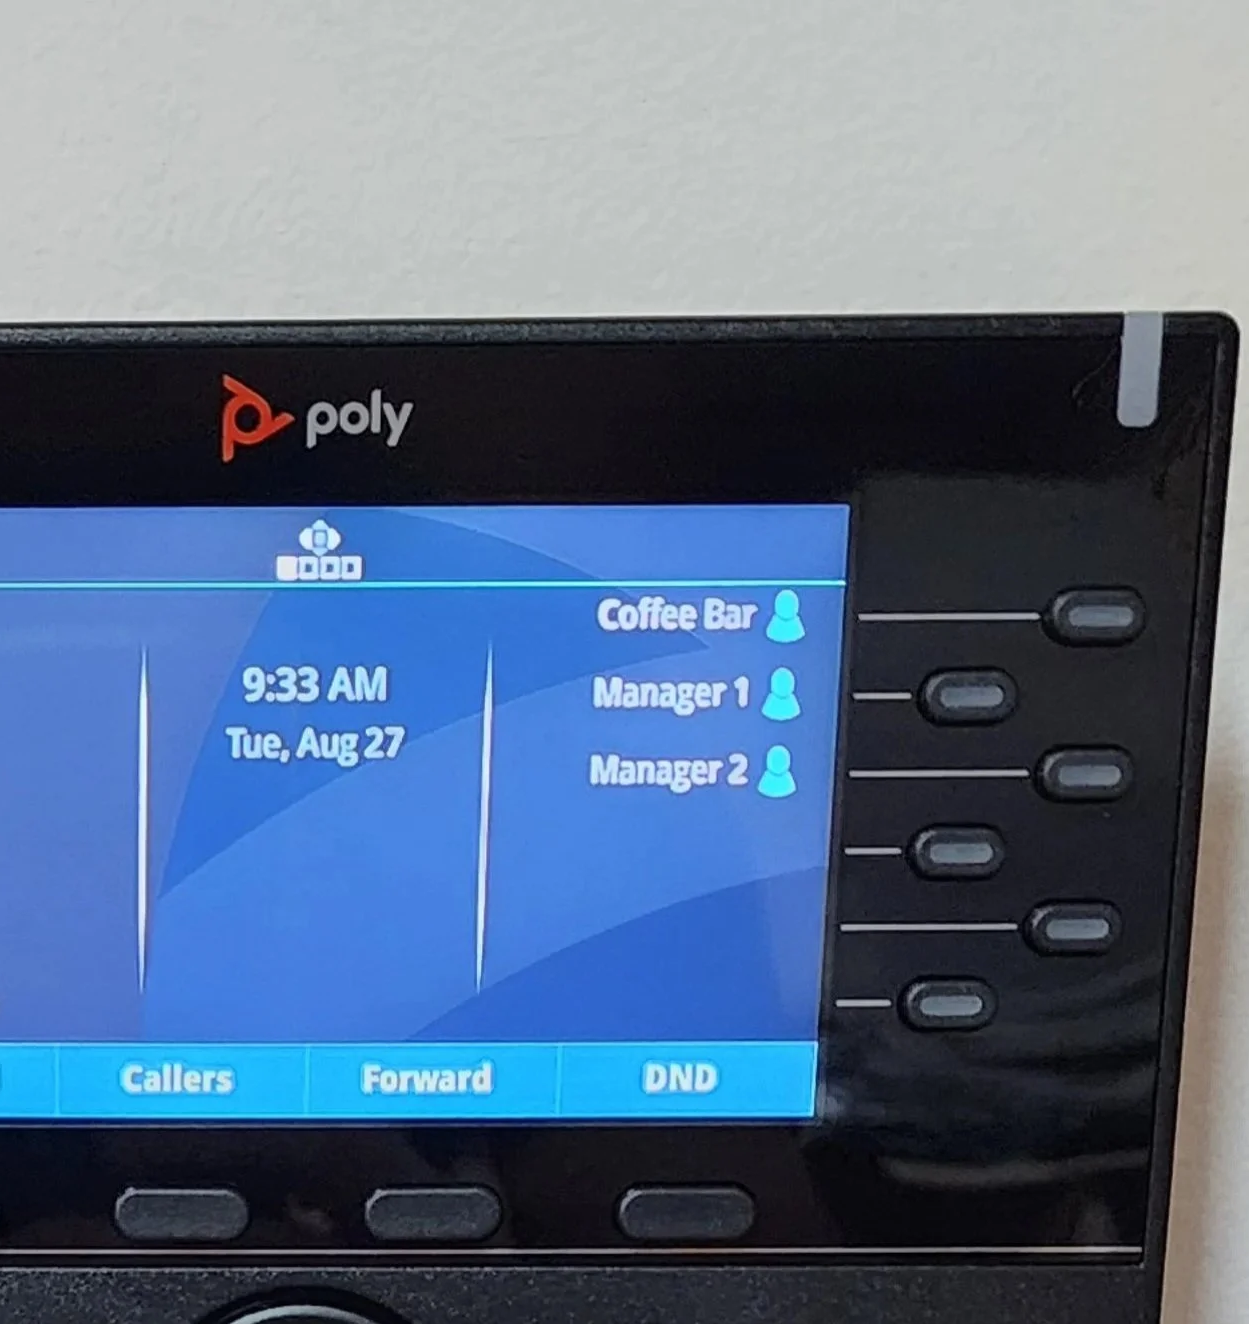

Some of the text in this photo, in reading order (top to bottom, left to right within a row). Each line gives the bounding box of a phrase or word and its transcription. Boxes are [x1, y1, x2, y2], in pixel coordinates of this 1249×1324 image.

[306, 388, 414, 449] poly
[597, 596, 759, 631] Coffee Bar
[242, 665, 387, 703] 9:33 AM
[593, 676, 750, 716] Manager 1
[225, 726, 406, 767] Tue, Aug 27
[590, 753, 749, 794] Manager 2
[121, 1063, 234, 1094] Callers
[362, 1062, 493, 1094] Forward
[644, 1063, 717, 1093] DND
